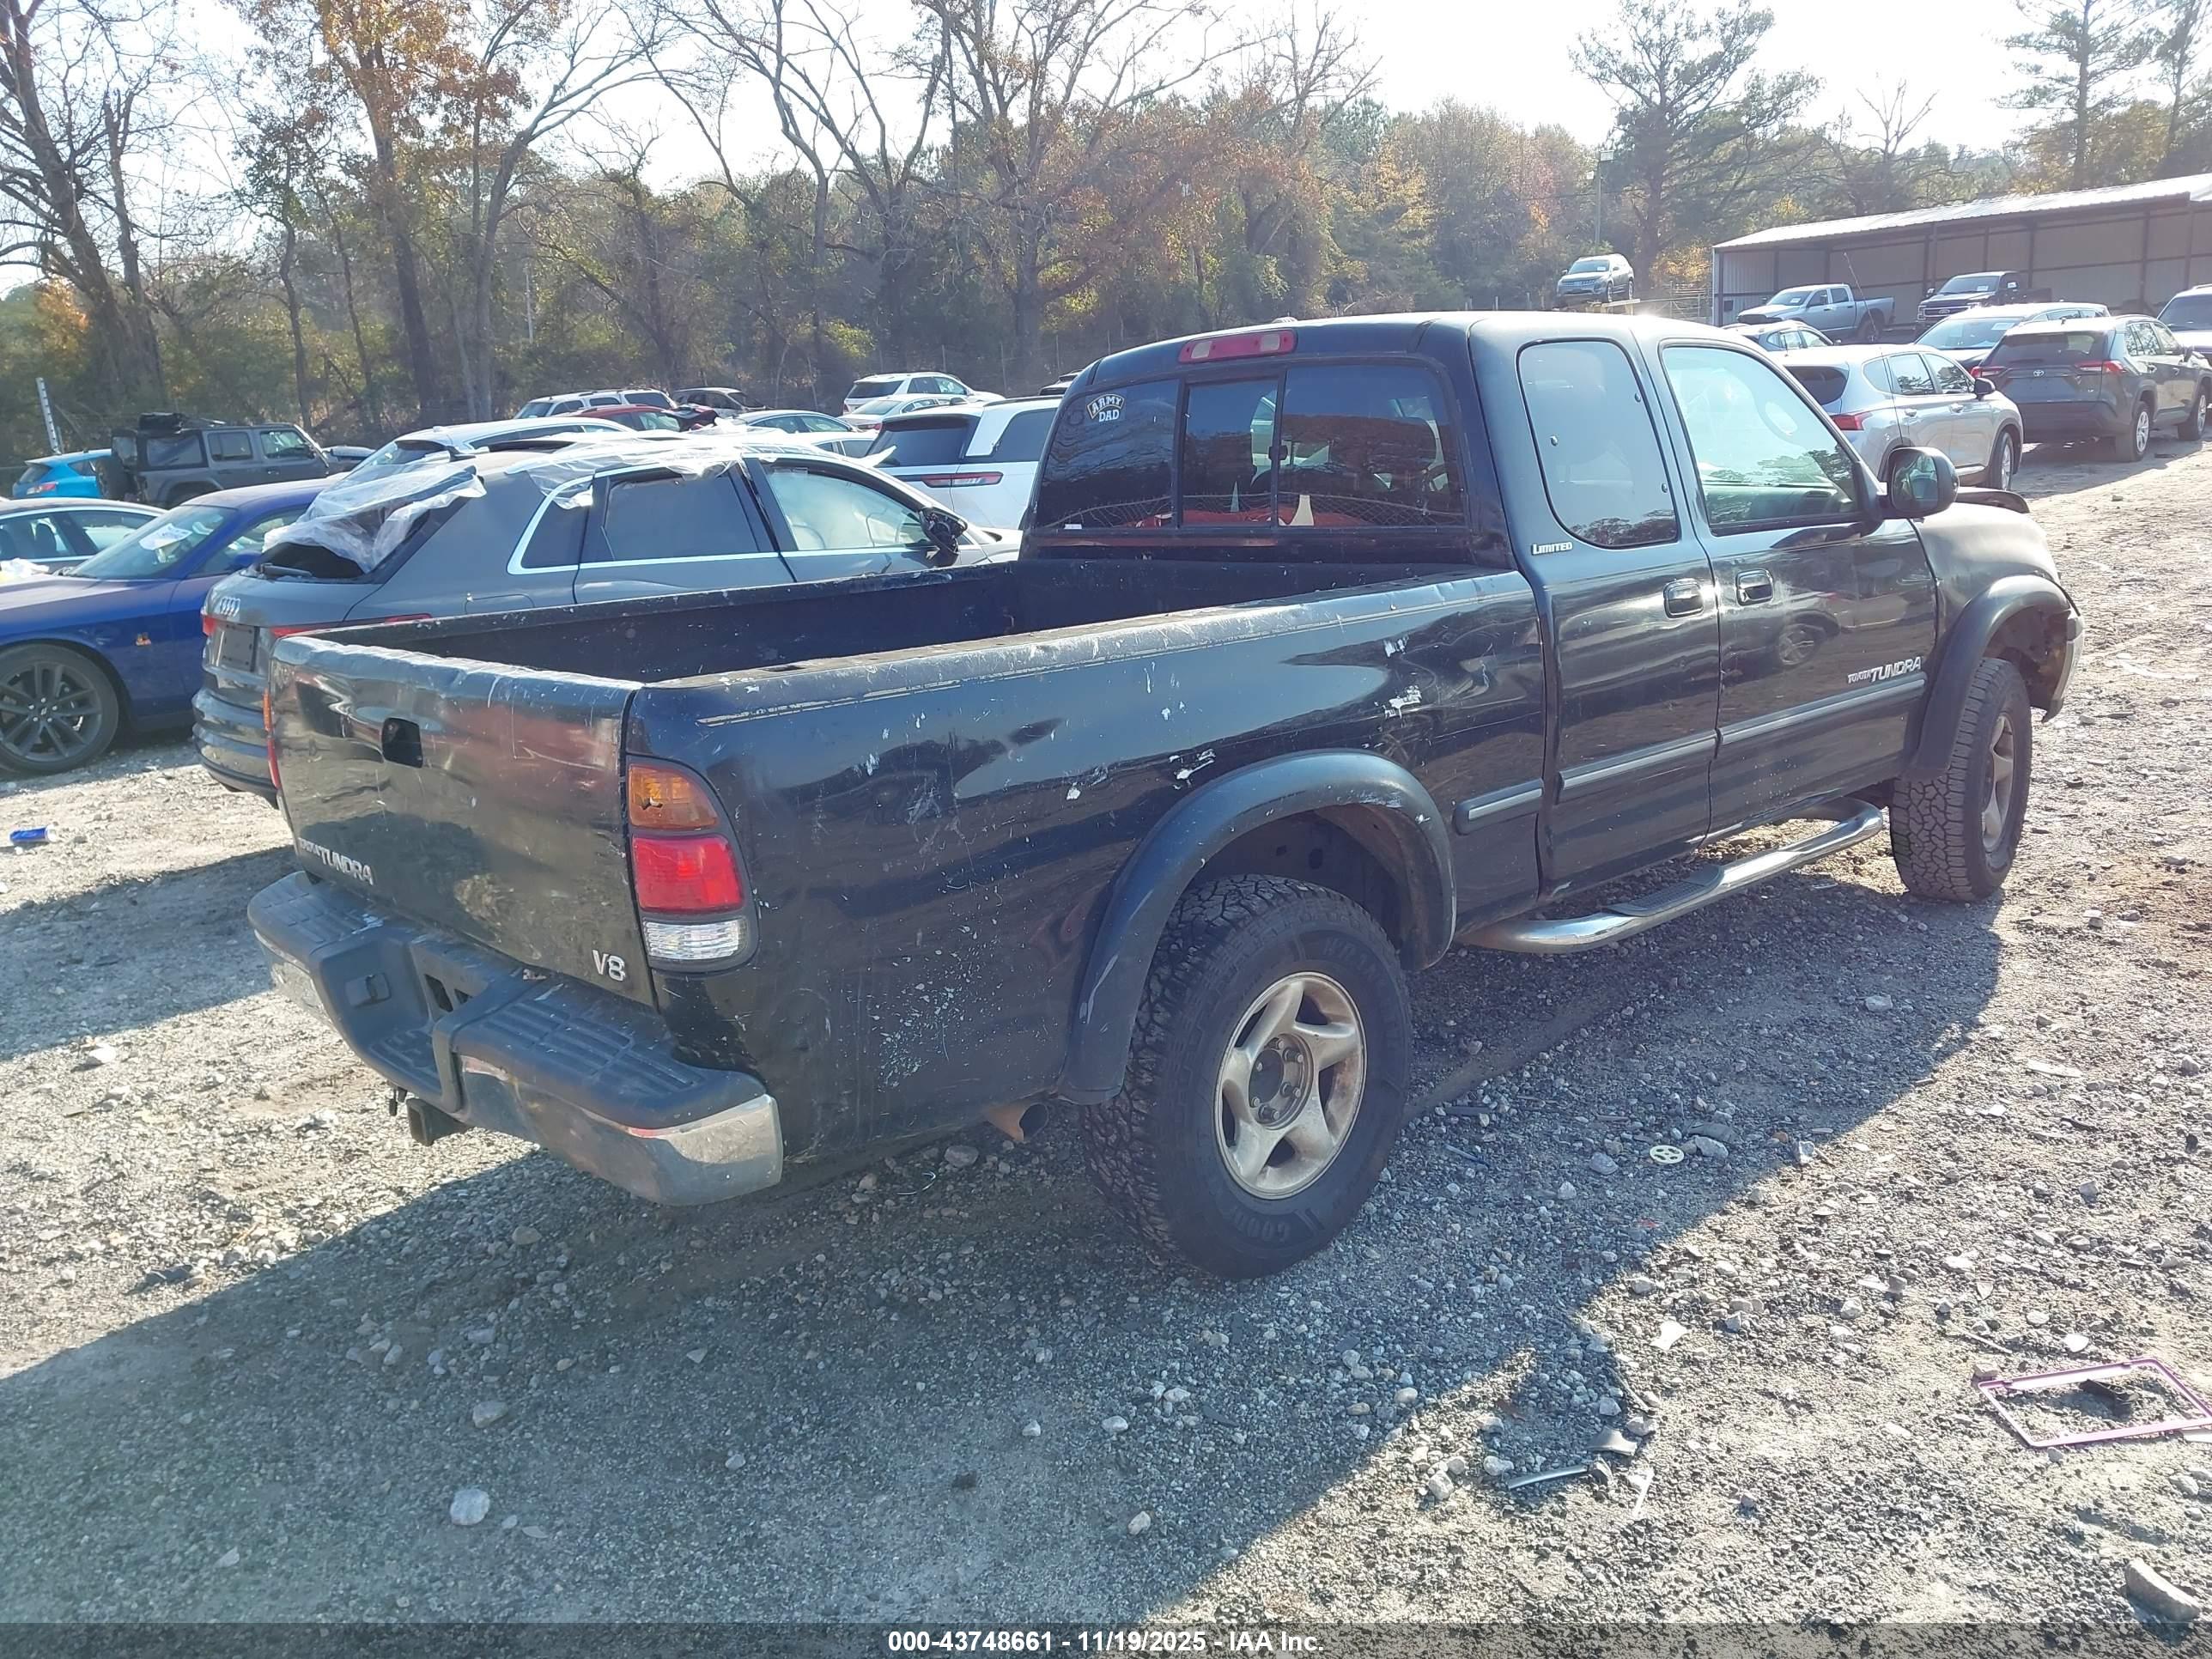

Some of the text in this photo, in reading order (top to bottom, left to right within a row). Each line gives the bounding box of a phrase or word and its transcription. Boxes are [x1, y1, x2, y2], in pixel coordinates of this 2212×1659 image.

[1091, 396, 1122, 415] ARMY
[1098, 409, 1120, 422] DAD
[1532, 541, 1573, 556] LIMITED
[1871, 656, 1922, 683] TUNDRA
[319, 846, 374, 885] TUNDRA
[592, 949, 626, 981] V8
